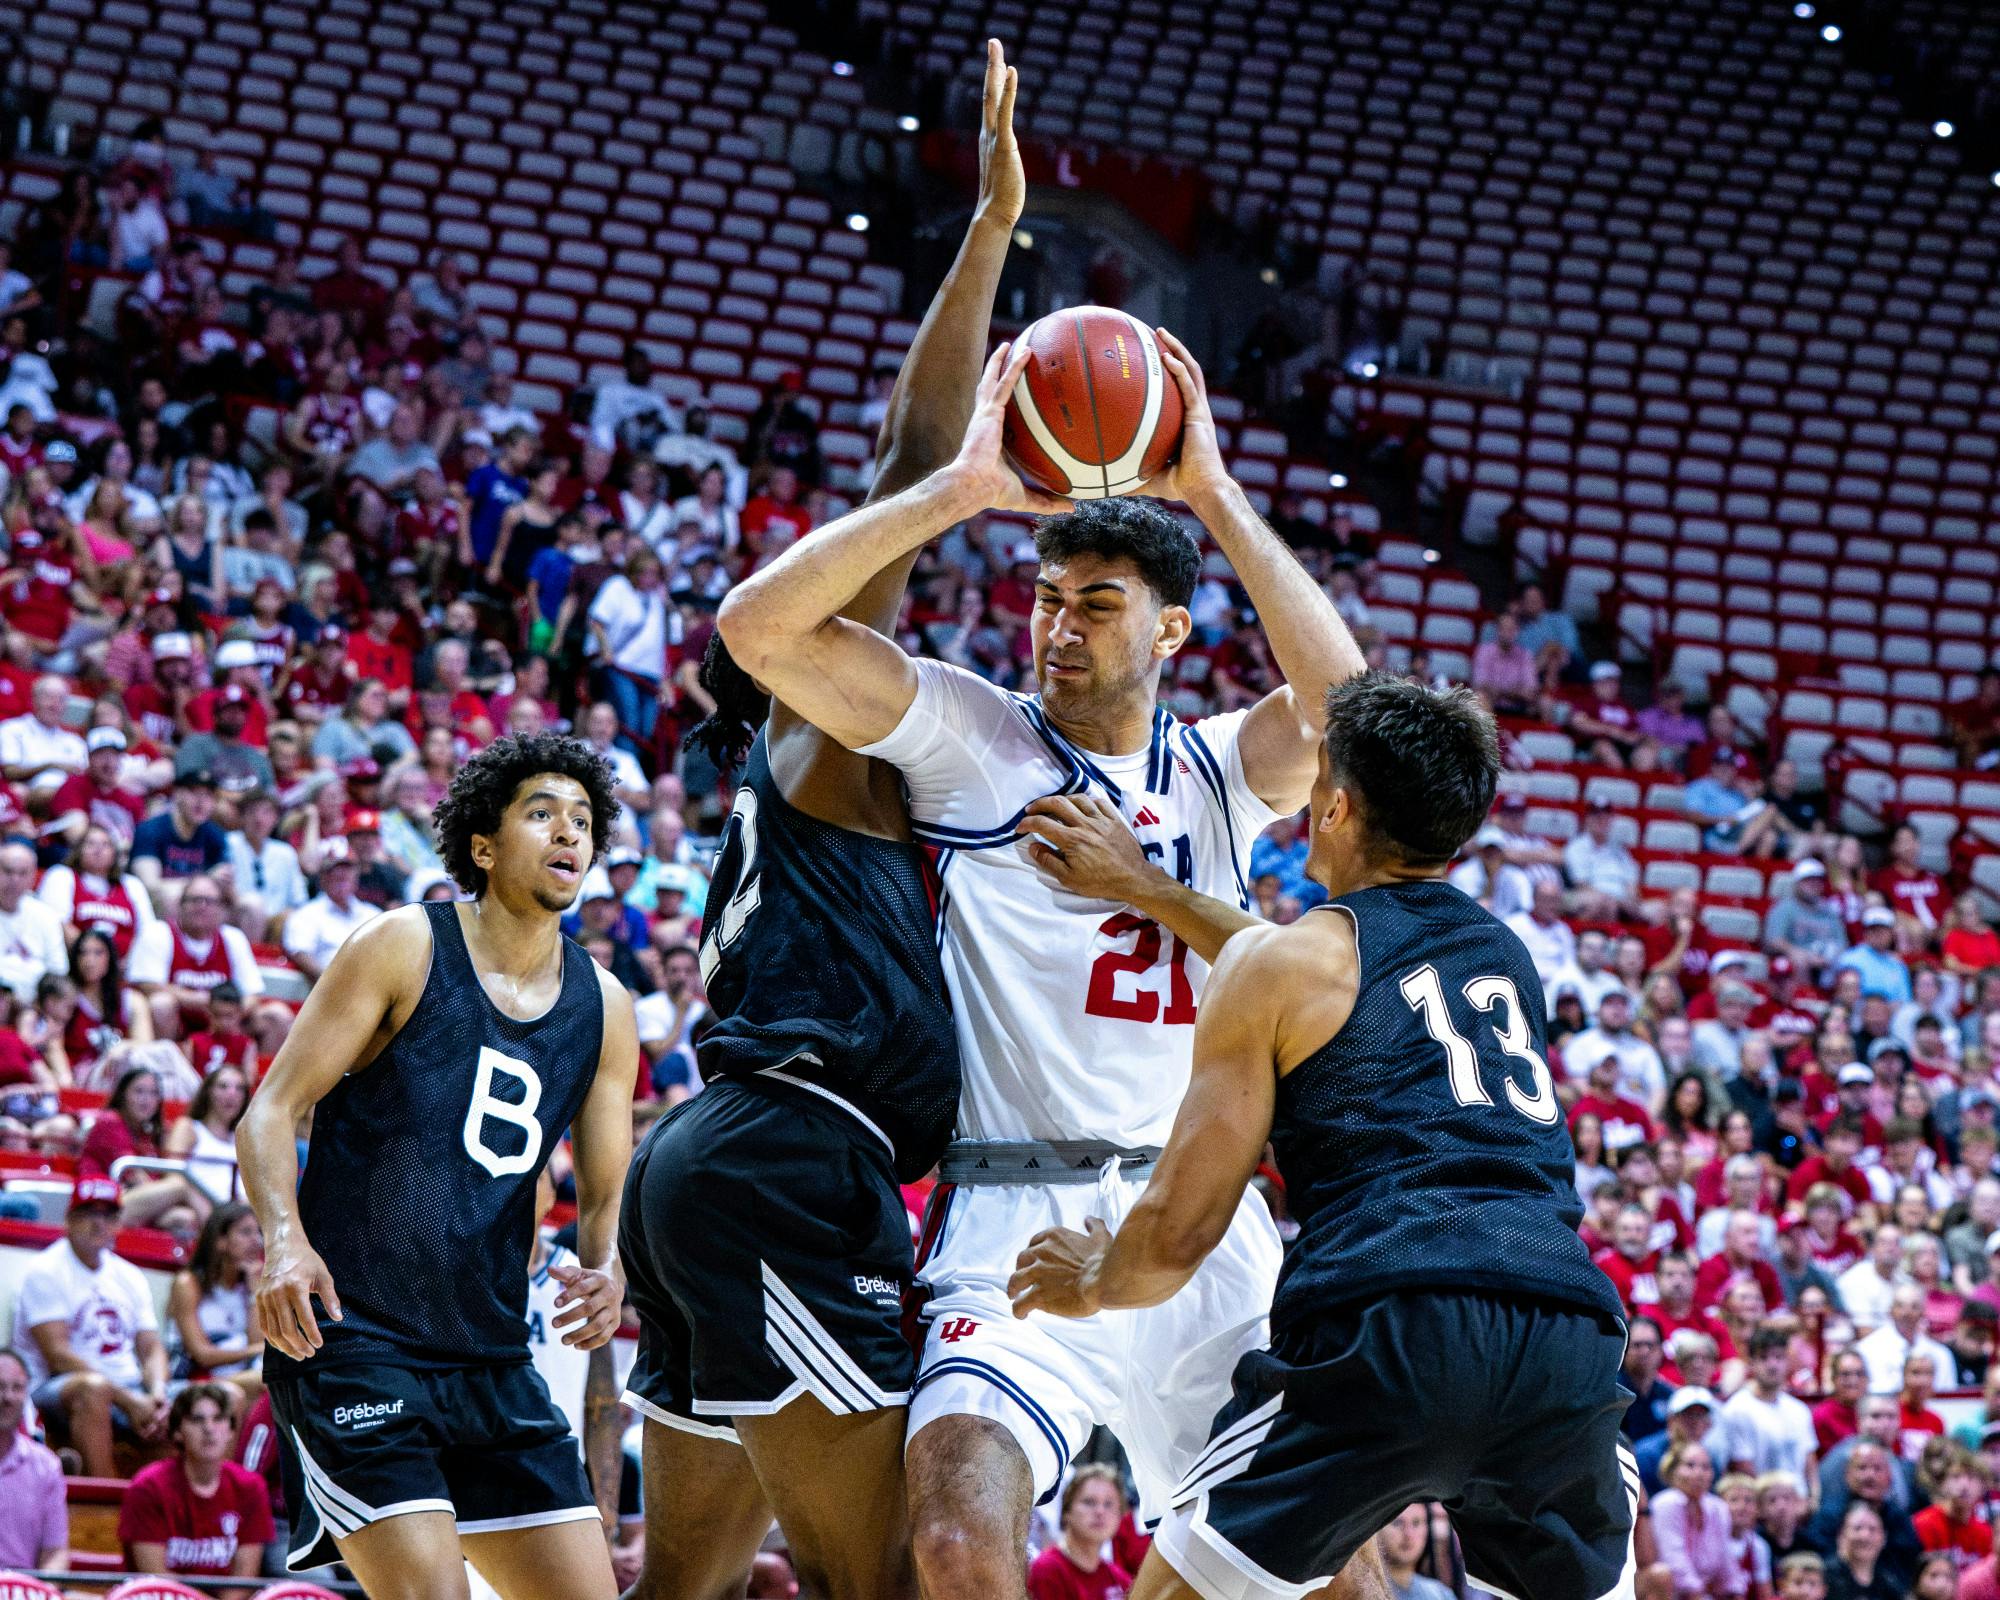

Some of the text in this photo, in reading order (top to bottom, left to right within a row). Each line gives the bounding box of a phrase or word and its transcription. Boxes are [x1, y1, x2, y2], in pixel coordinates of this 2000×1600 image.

[1085, 911, 1198, 1025] 21
[1399, 963, 1559, 1125] 13
[463, 1045, 543, 1178] B
[334, 1399, 404, 1425] Brébeuf
[352, 1418, 386, 1430] BASKETBALL
